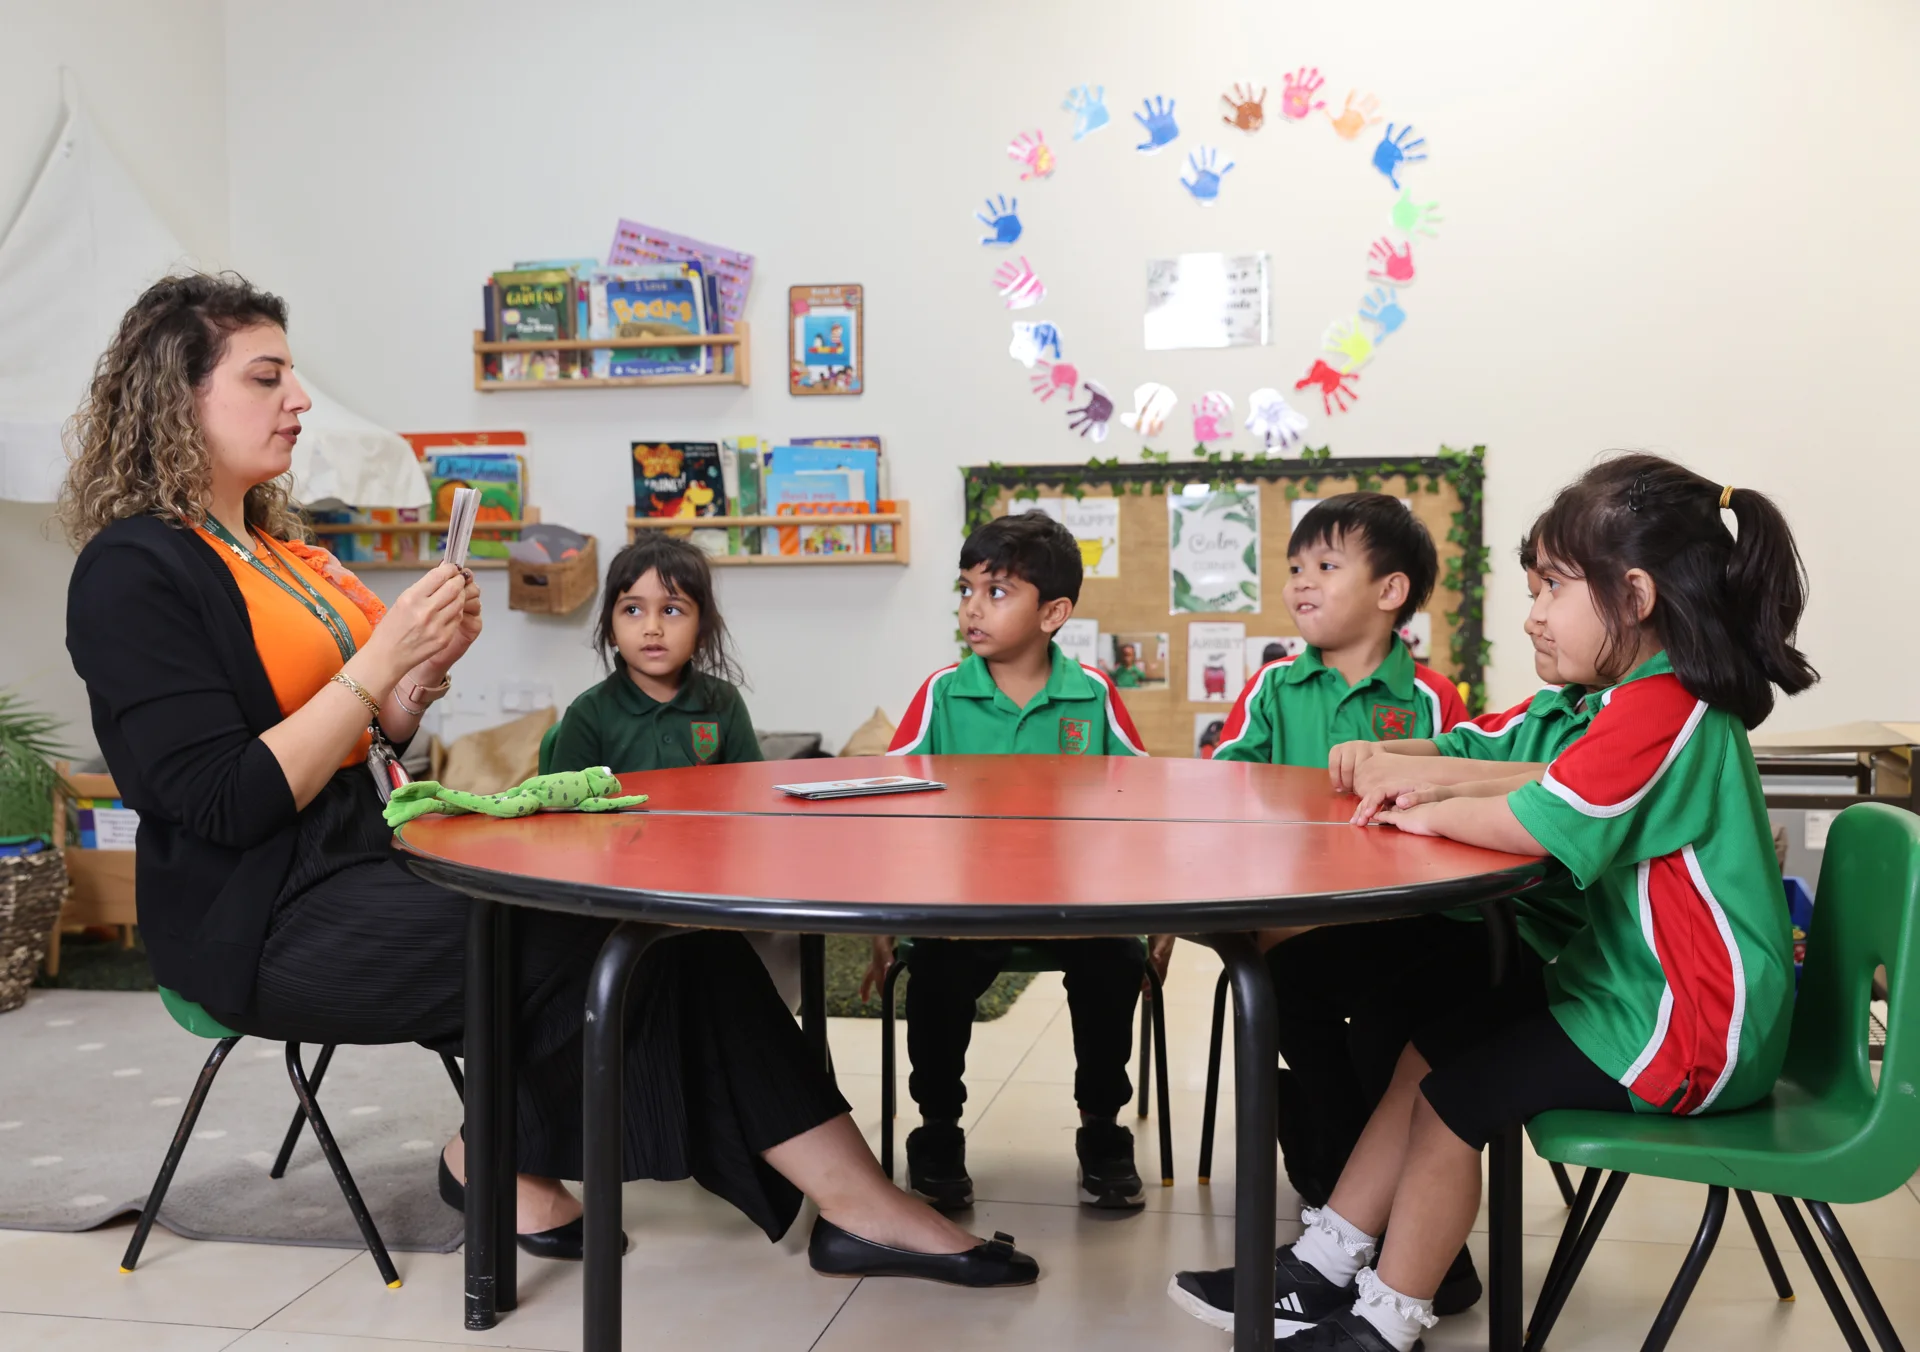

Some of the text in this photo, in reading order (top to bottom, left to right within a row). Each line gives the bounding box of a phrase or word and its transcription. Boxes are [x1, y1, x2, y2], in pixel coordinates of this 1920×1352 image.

[612, 297, 692, 324] Bears
[1067, 514, 1116, 528] HAPPY
[1188, 530, 1241, 555] Calm
[1059, 634, 1091, 648] ALM
